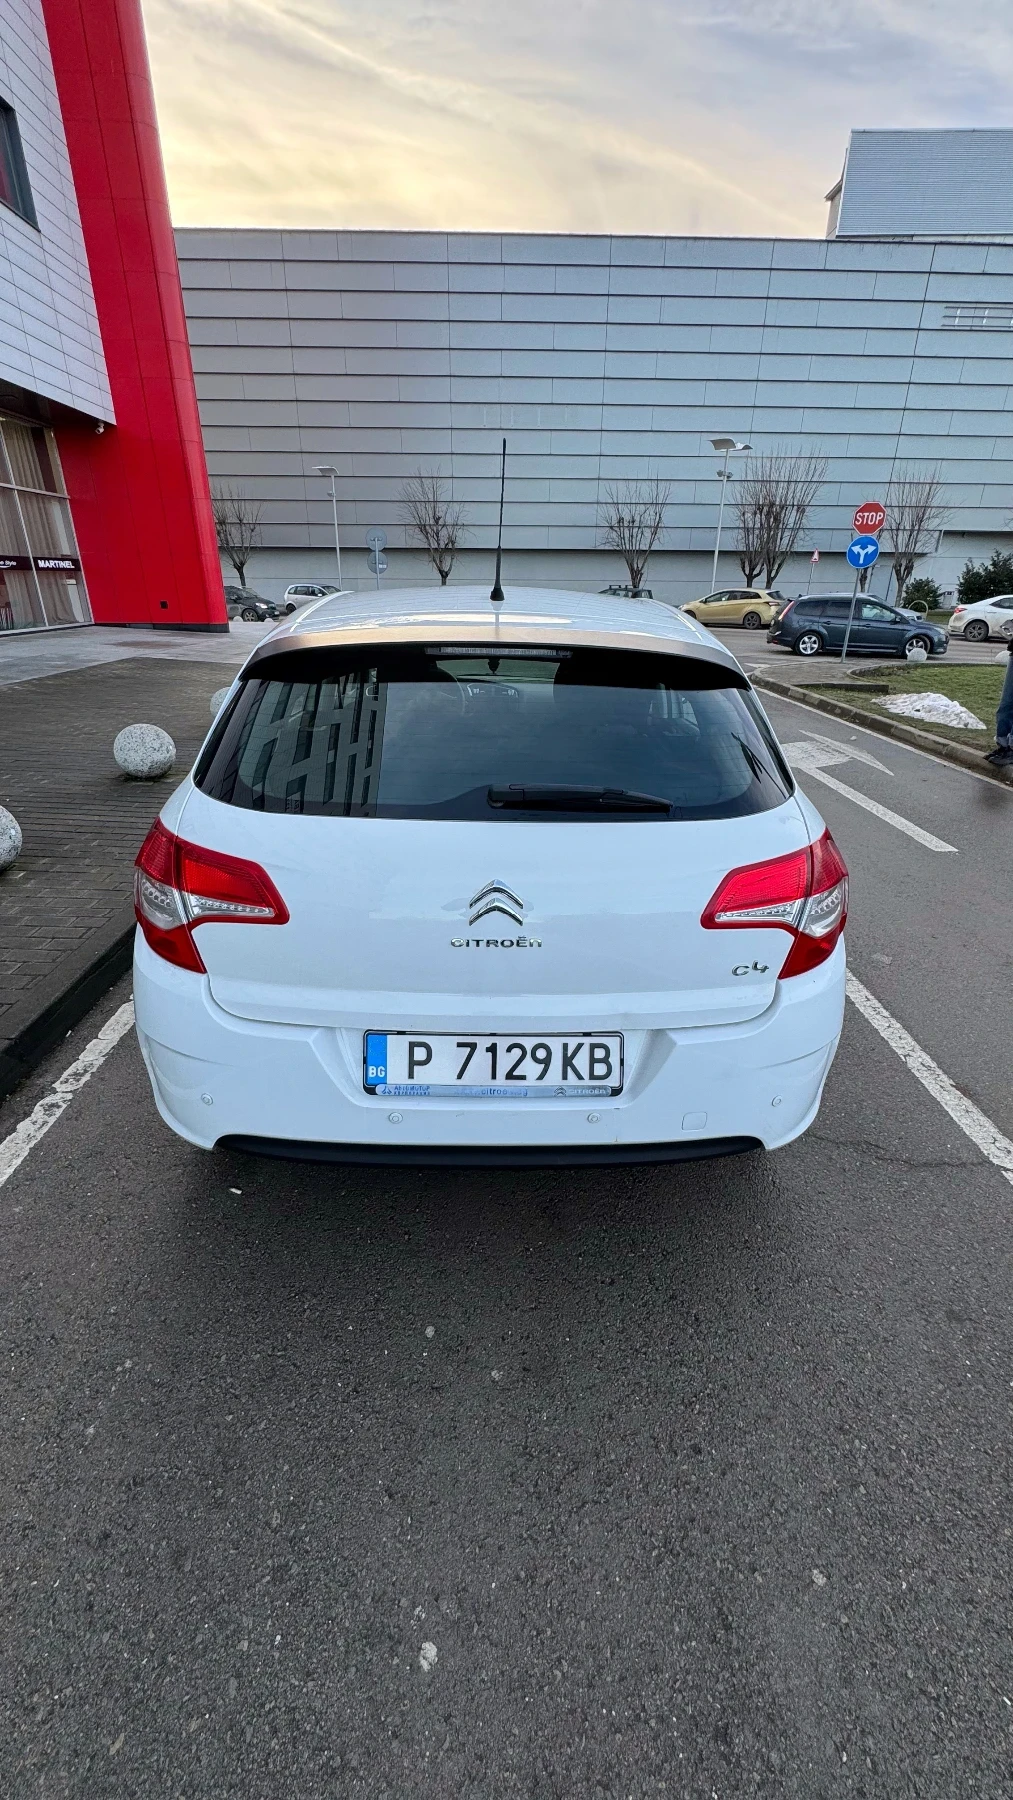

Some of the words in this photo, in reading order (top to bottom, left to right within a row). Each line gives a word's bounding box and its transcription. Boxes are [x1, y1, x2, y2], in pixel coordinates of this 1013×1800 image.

[855, 512, 884, 525] STOP
[37, 560, 75, 569] MARTINEL
[450, 935, 543, 948] CITROËN
[731, 960, 770, 977] C4
[408, 1041, 433, 1080] P
[368, 1065, 386, 1078] BG
